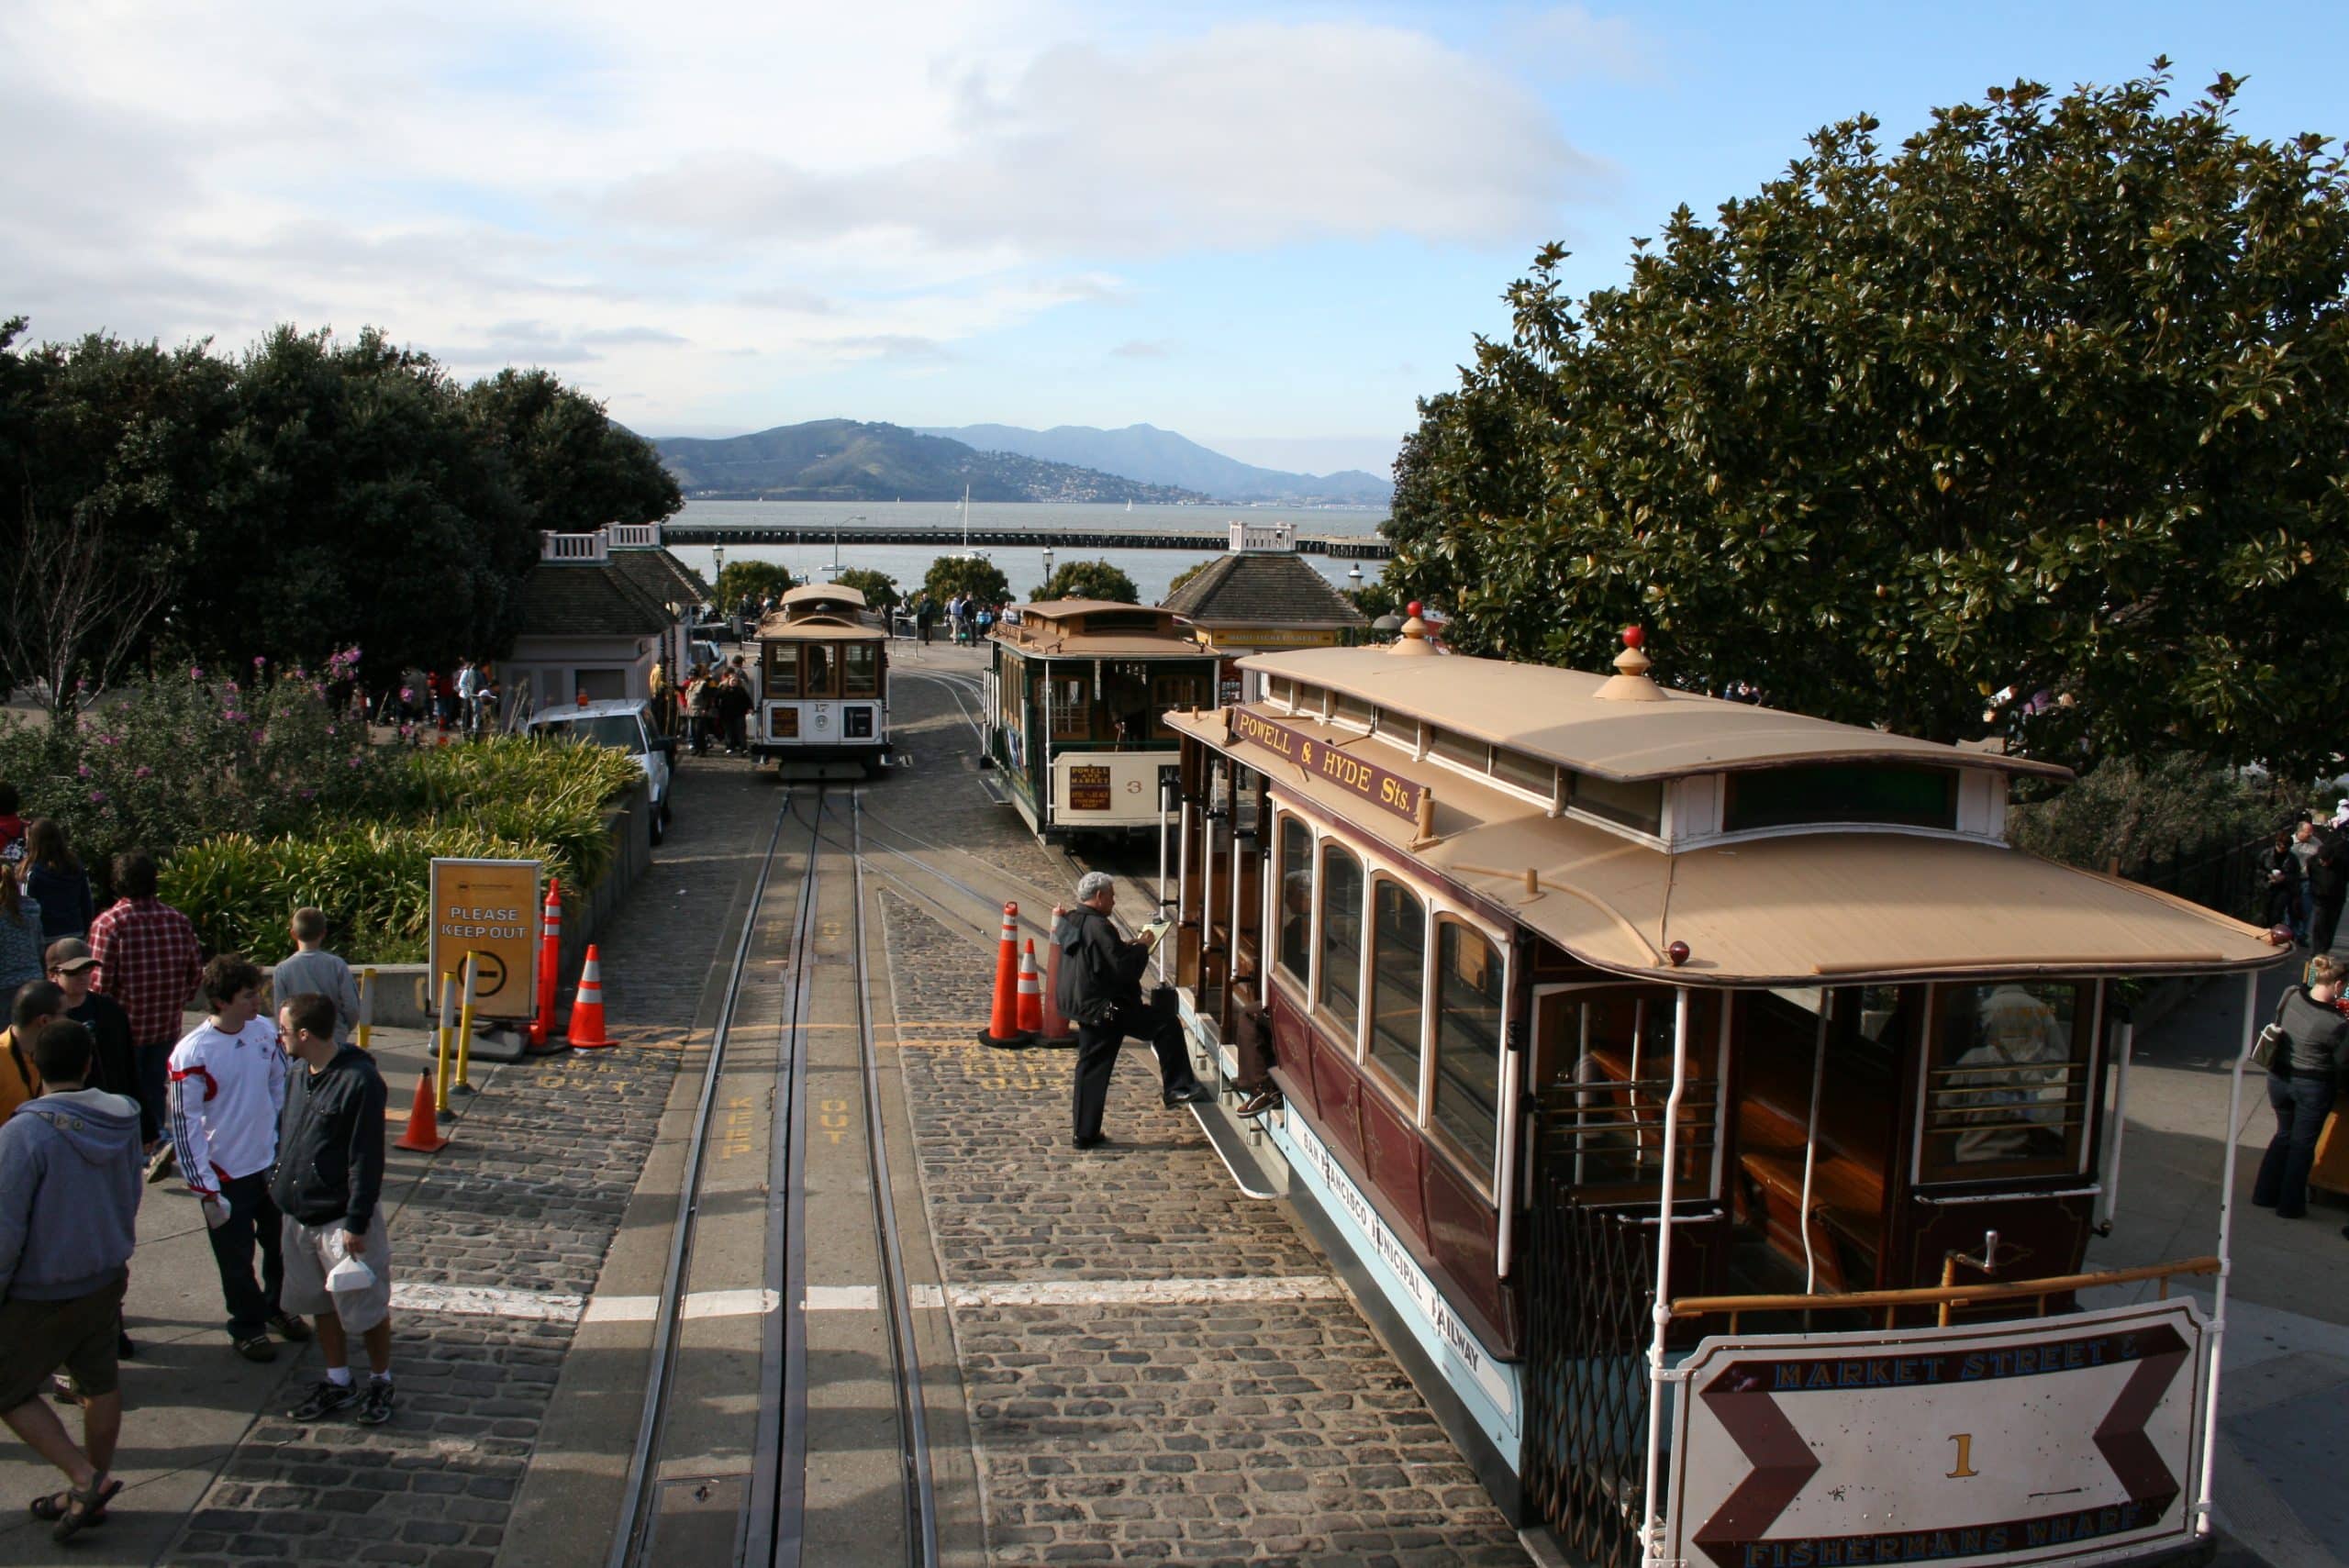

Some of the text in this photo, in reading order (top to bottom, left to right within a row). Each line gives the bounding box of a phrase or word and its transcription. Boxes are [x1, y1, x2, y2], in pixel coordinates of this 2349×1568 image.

[1239, 713, 1410, 811] POWELL & HYDE Sts.
[1126, 780, 1142, 795] 3
[440, 924, 528, 939] KEEP OUT
[449, 906, 518, 921] PLEASE
[721, 1096, 753, 1160] KEEP
[820, 1098, 848, 1145] OUT
[1303, 1132, 1319, 1162] SAN
[1775, 1358, 1945, 1389] MARKET
[1961, 1340, 2109, 1380] STREET
[1944, 1433, 1979, 1480] 1
[1744, 1504, 2142, 1568] FISHERMANS WHARF
